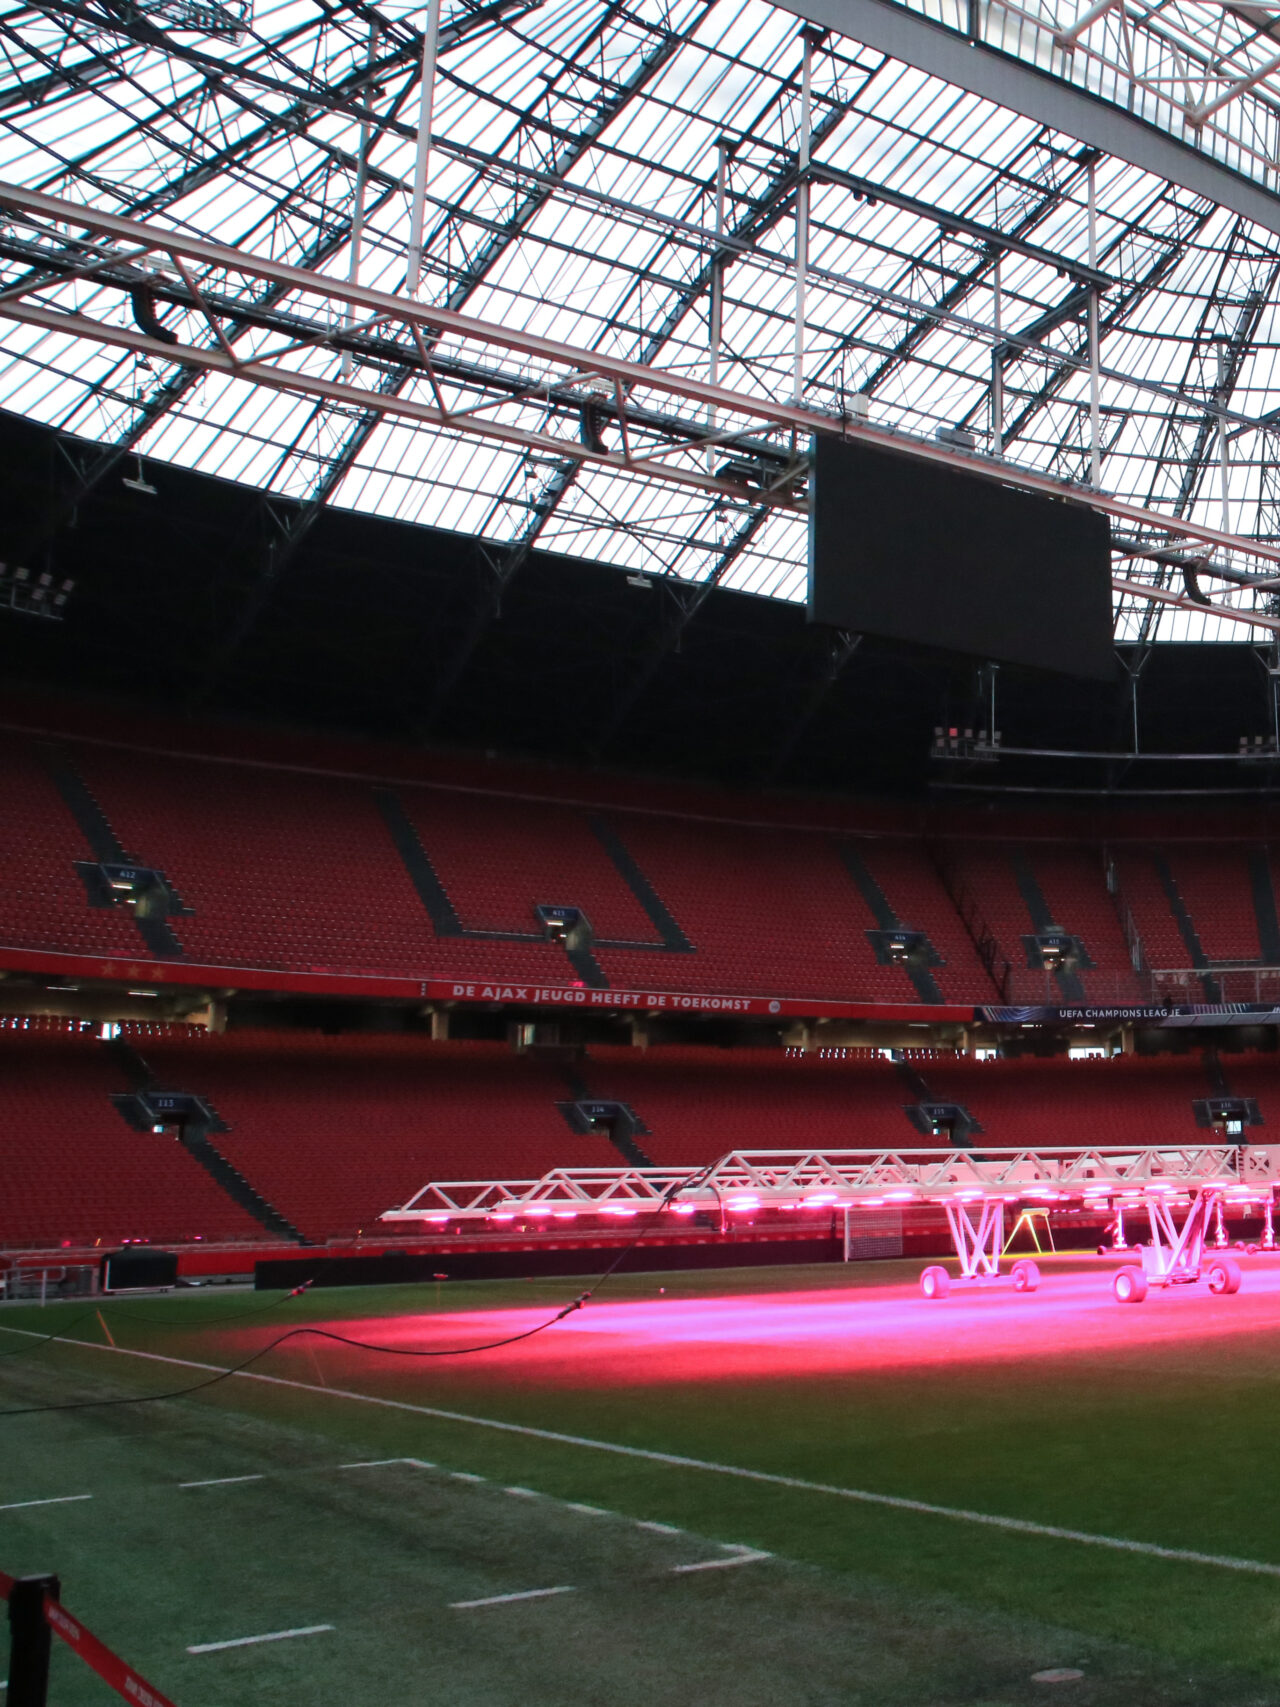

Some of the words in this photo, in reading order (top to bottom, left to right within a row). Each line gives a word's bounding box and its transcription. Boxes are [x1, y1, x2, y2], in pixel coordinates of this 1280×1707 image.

[453, 984, 475, 997] DE
[481, 986, 528, 1000] AJAX
[534, 989, 586, 1003] JEUGD
[591, 992, 640, 1005] HEEFT
[647, 995, 666, 1007] DE
[672, 996, 751, 1010] TOEKOMST
[1060, 1009, 1084, 1018] UEFA
[1085, 1009, 1142, 1018] CHAMPIONS
